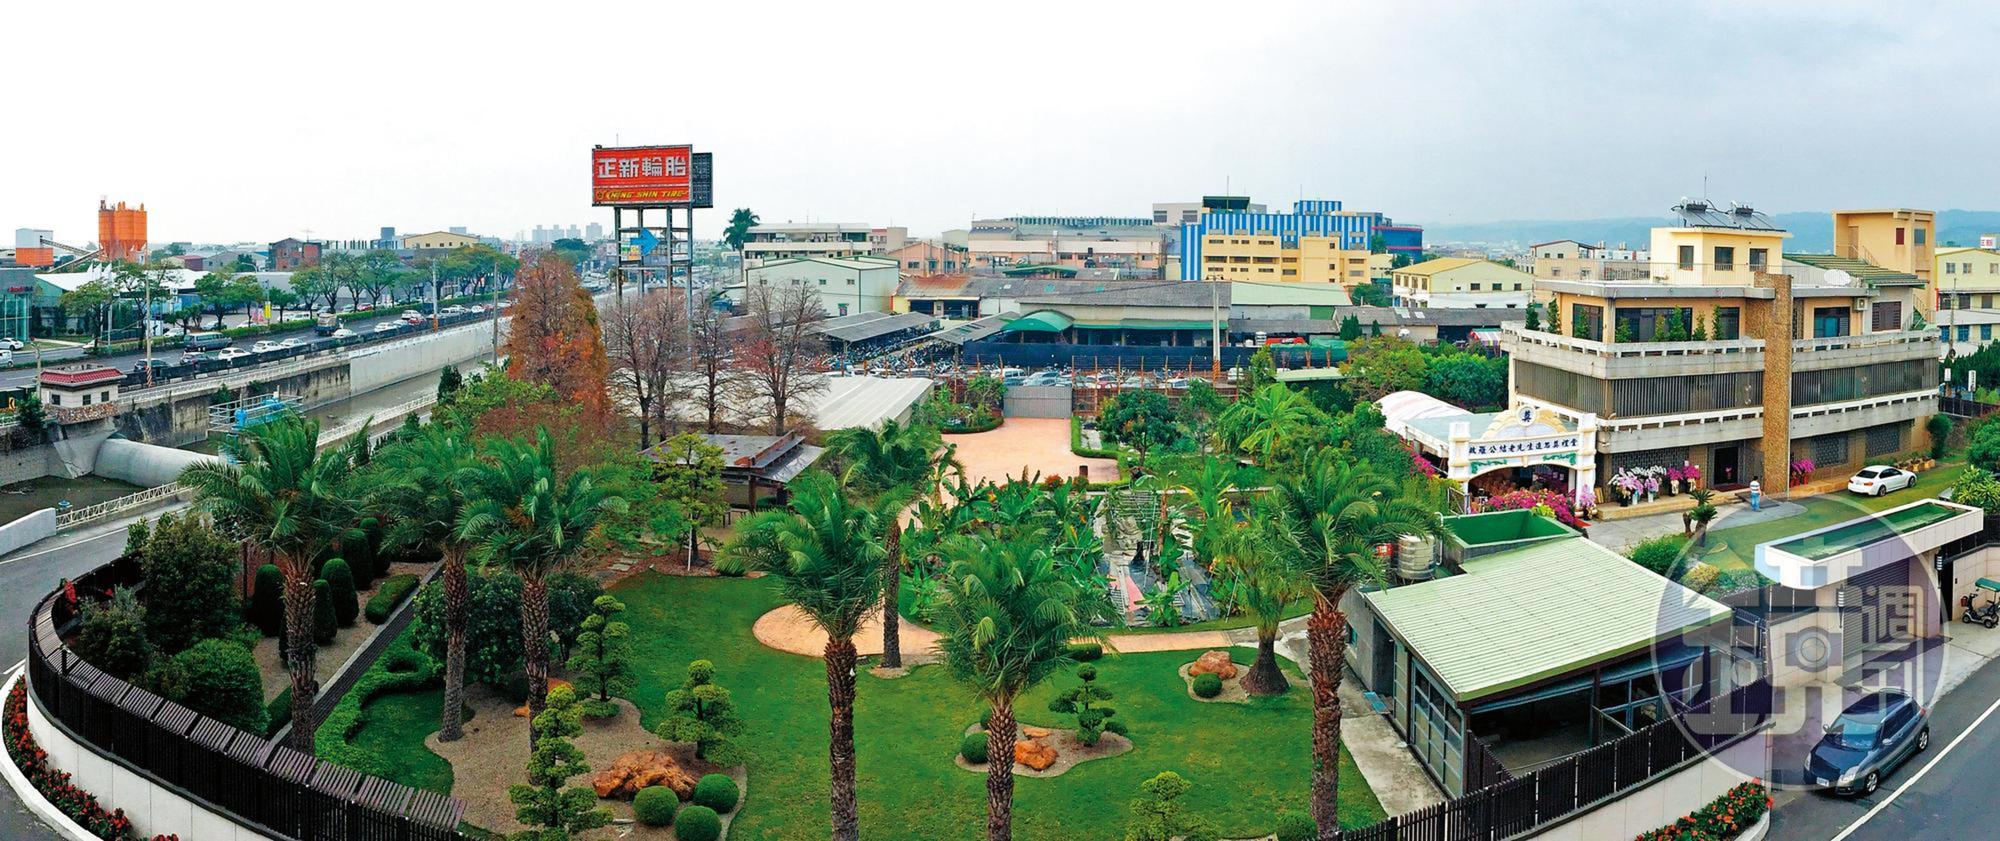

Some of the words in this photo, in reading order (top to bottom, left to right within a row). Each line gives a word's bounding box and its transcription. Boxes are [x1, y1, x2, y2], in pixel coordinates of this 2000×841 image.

[598, 156, 686, 178] 正新輪胎
[637, 190, 658, 198] SHIN
